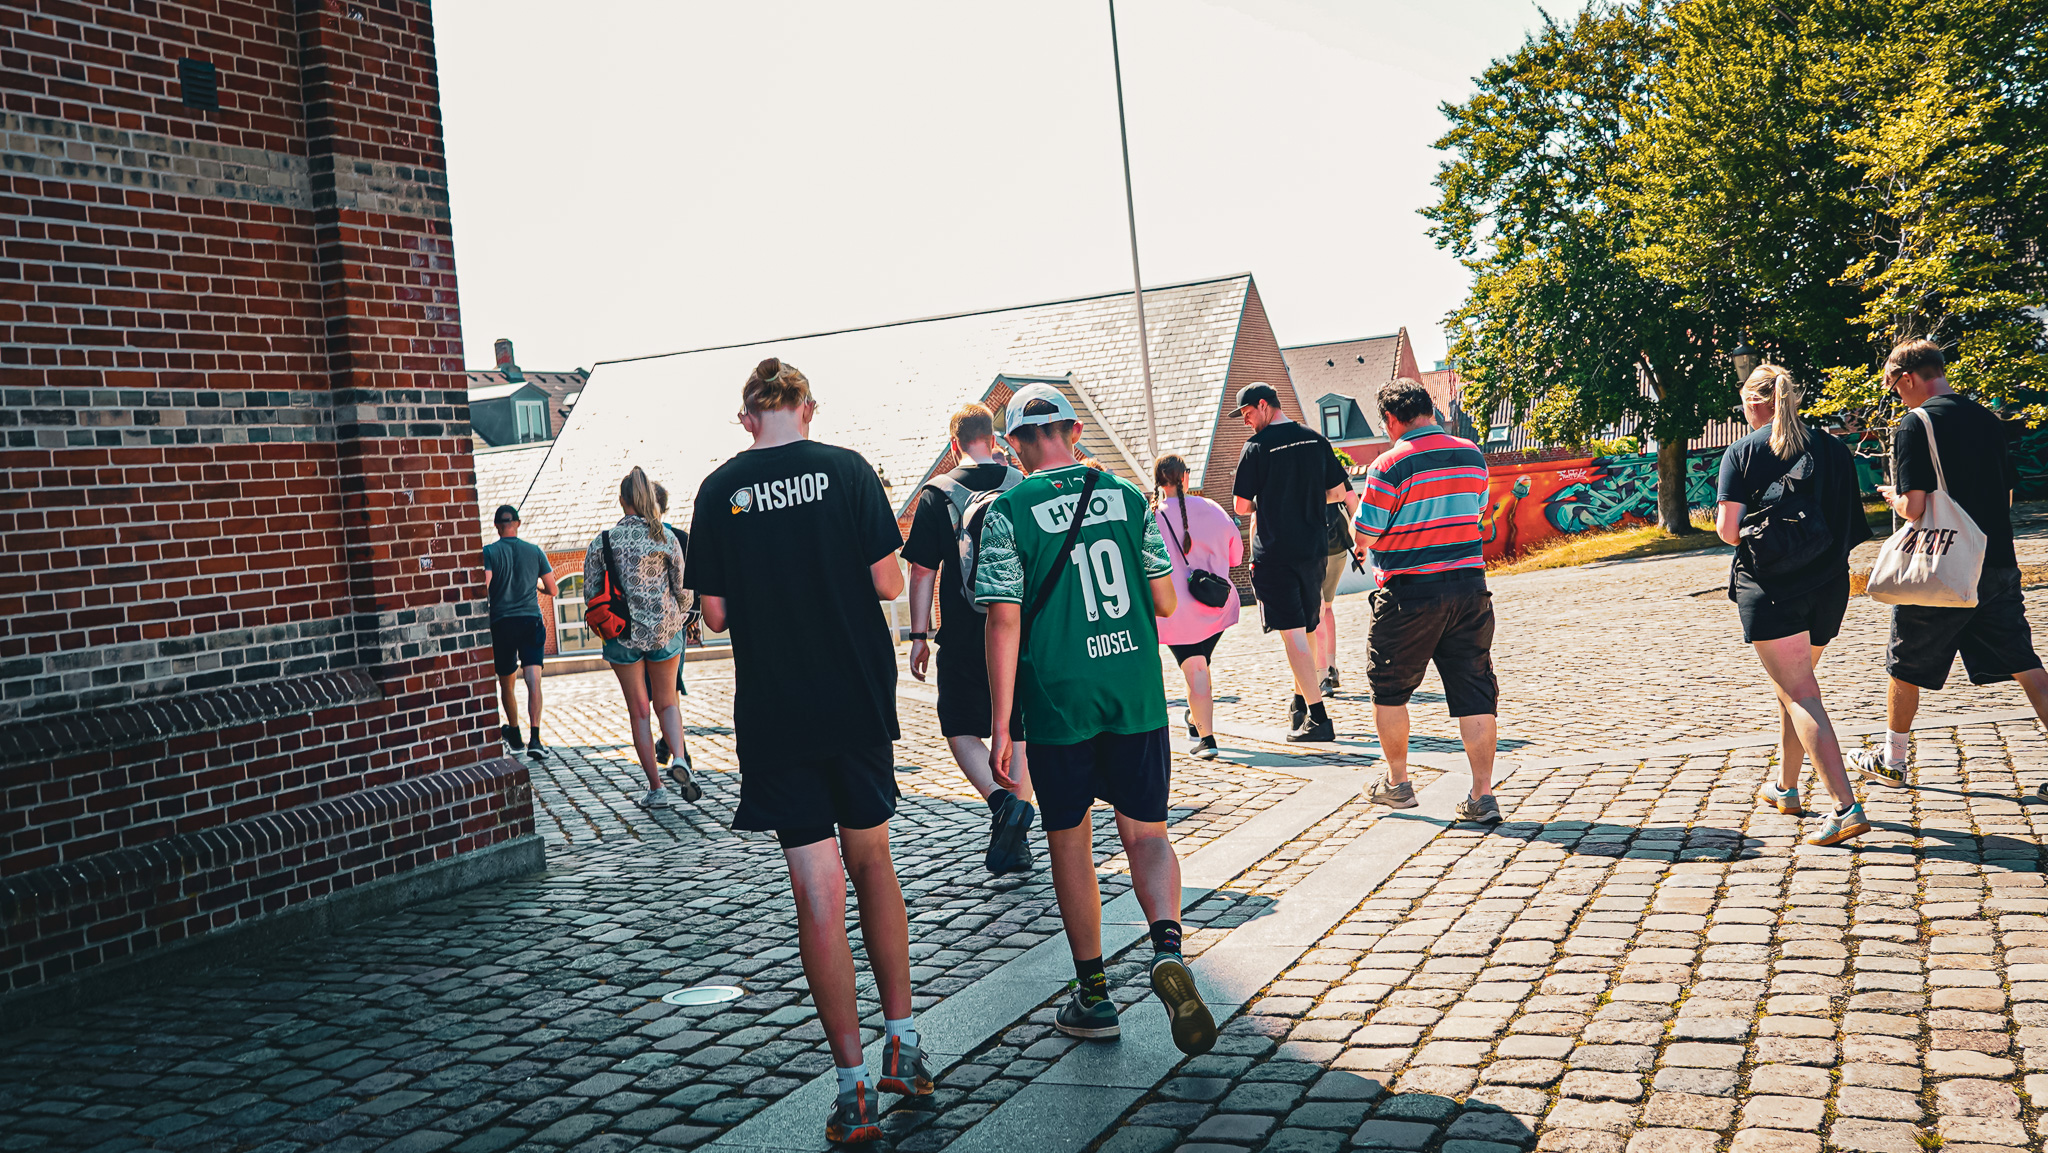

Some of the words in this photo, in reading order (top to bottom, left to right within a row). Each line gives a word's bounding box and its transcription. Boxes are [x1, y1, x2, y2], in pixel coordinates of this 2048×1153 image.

[754, 473, 829, 512] HSHOP
[1070, 539, 1131, 622] 19
[1086, 630, 1139, 659] GIDSEL
